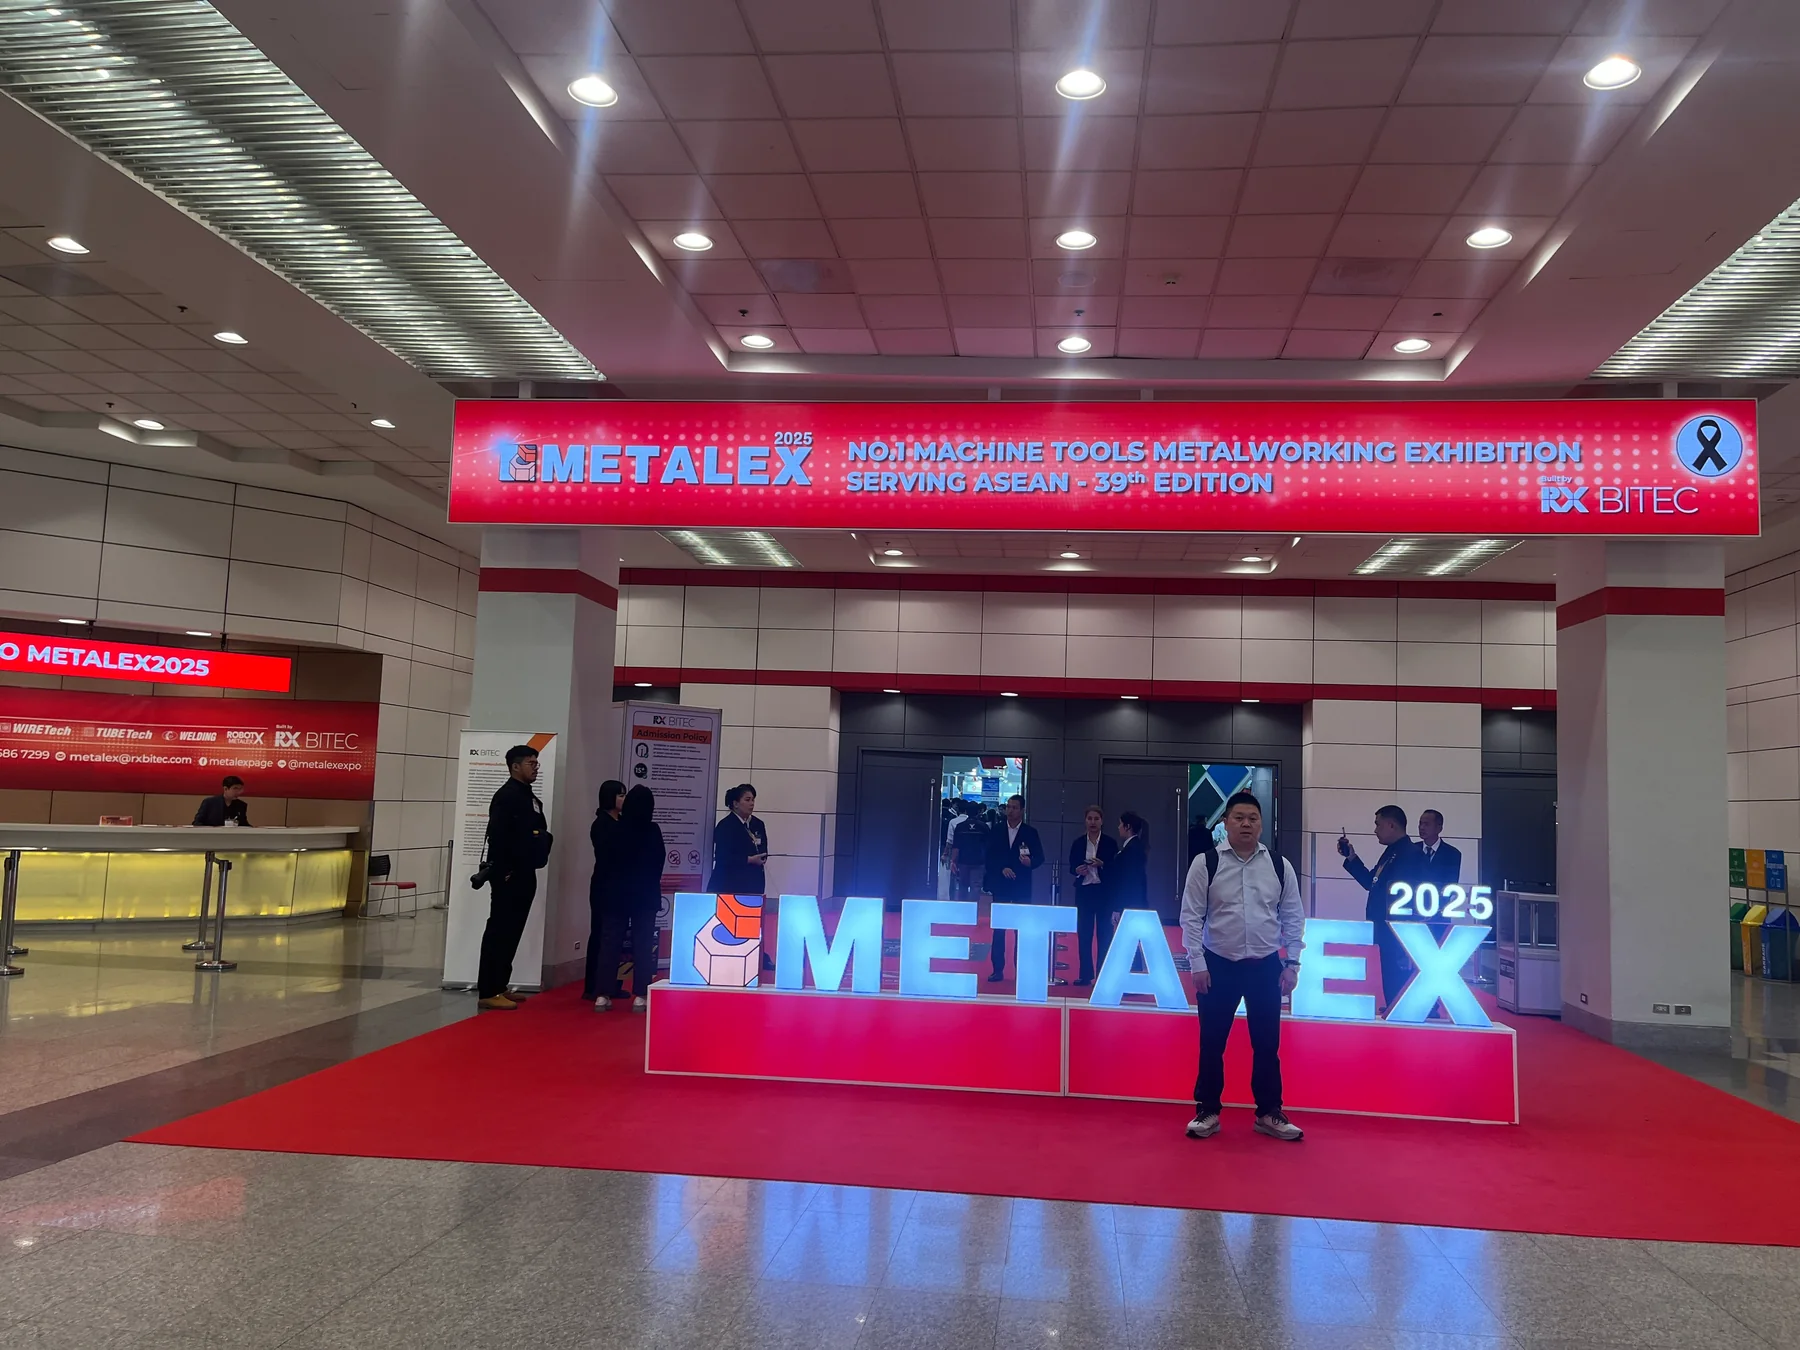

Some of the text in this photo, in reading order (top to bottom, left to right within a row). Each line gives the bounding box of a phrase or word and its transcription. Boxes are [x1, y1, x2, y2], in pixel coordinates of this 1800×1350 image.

[774, 432, 813, 446] 2025
[848, 441, 1582, 463] NO.1 MACHINE TOOLS METALWORKING EXHIBITION
[541, 444, 813, 486] METALEX
[847, 471, 967, 492] SERVING
[973, 472, 1069, 492] ASEAN
[1094, 470, 1146, 492] 39th
[1153, 472, 1273, 493] EDITION
[1562, 475, 1573, 483] by
[1541, 486, 1699, 513] RX BITEC
[27, 644, 210, 677] METALEX2025
[653, 715, 696, 727] RX BITEC
[13, 723, 72, 736] WIRETech
[96, 727, 153, 740] TUBETech
[179, 731, 218, 742] WELDING
[274, 731, 359, 750] RX BITEC
[636, 729, 708, 744] Admission Policy
[21, 749, 50, 760] 7299
[69, 752, 192, 765] metalex@rxbitec.com
[480, 749, 500, 757] BITEC
[209, 756, 274, 769] metalexpage
[288, 759, 362, 771] @metalexexpo
[1389, 881, 1494, 921] 2025
[775, 893, 1493, 1027] METAEX
